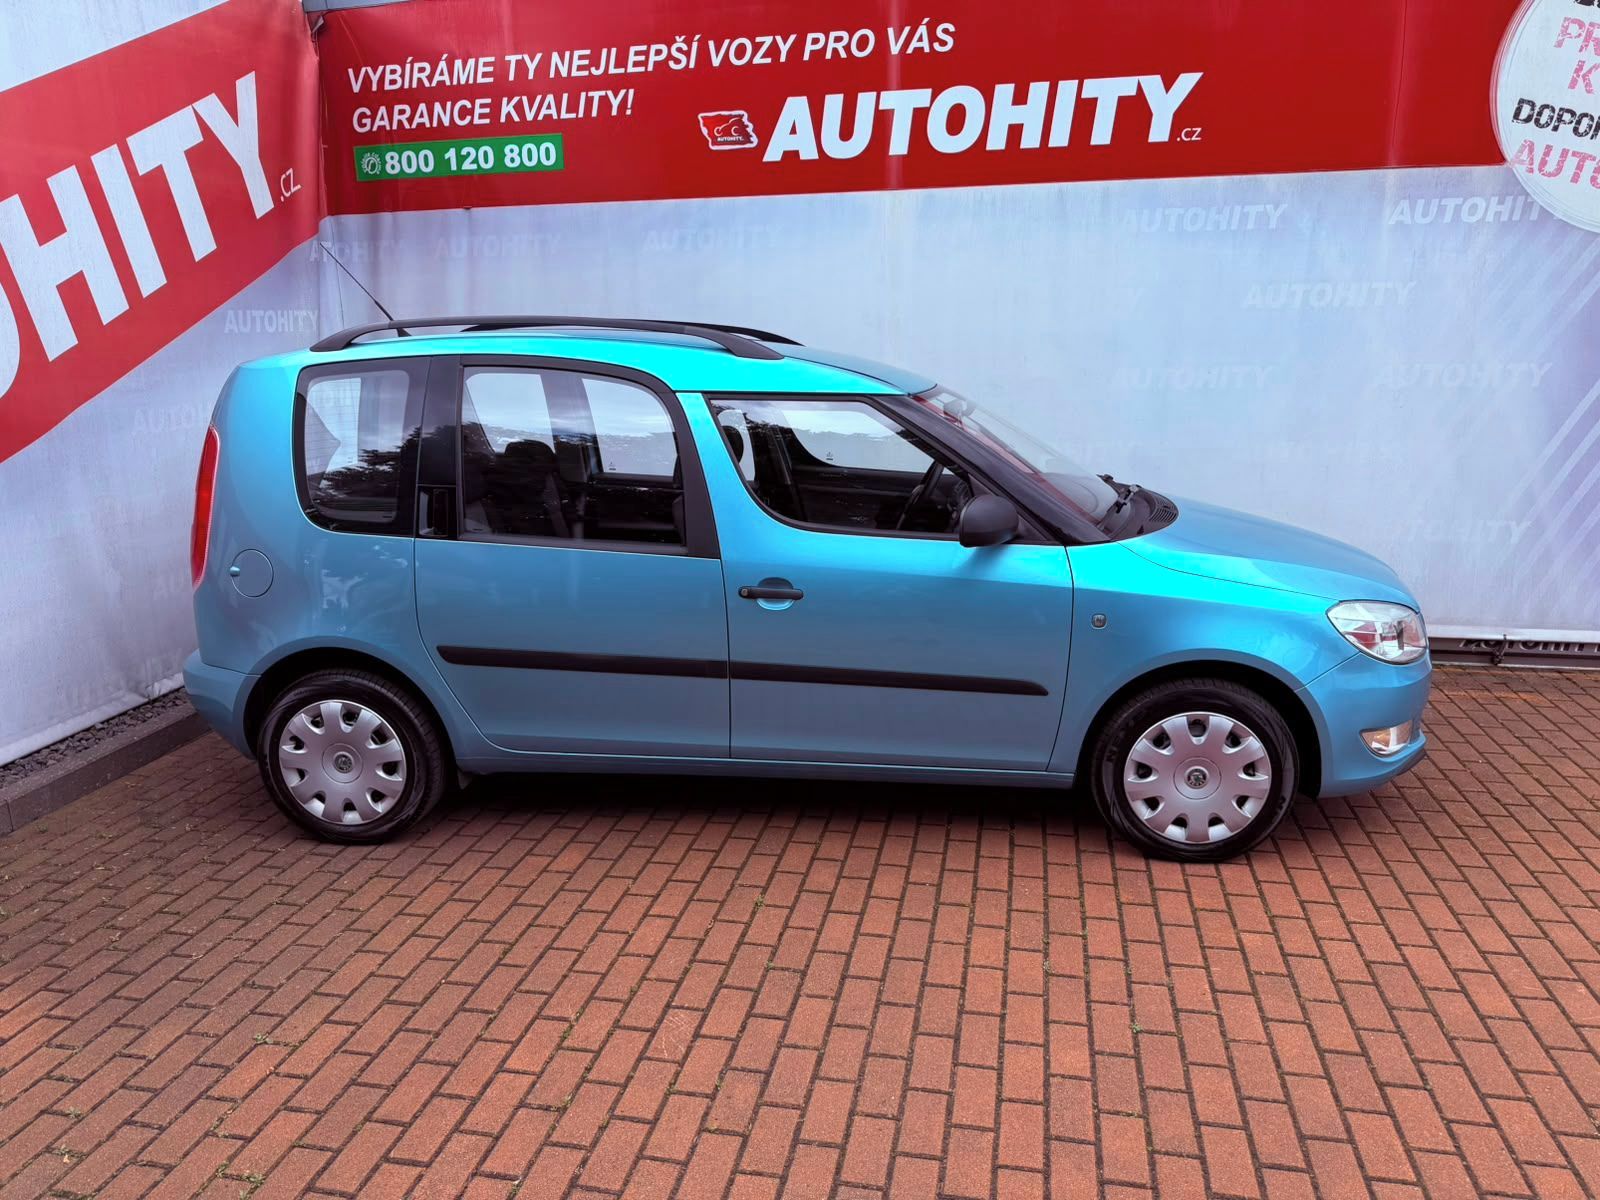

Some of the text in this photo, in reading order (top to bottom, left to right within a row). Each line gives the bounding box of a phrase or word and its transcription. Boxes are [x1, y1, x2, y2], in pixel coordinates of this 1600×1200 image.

[347, 17, 956, 93] VYBÍRÁME TY NEJLEPŠÍ VOZY PRO VÁS
[351, 88, 636, 133] GARANCE KVALITY!
[384, 149, 435, 175] 800
[443, 145, 495, 171] 120
[503, 141, 557, 168] 800
[223, 309, 319, 334] AUTOHITY
